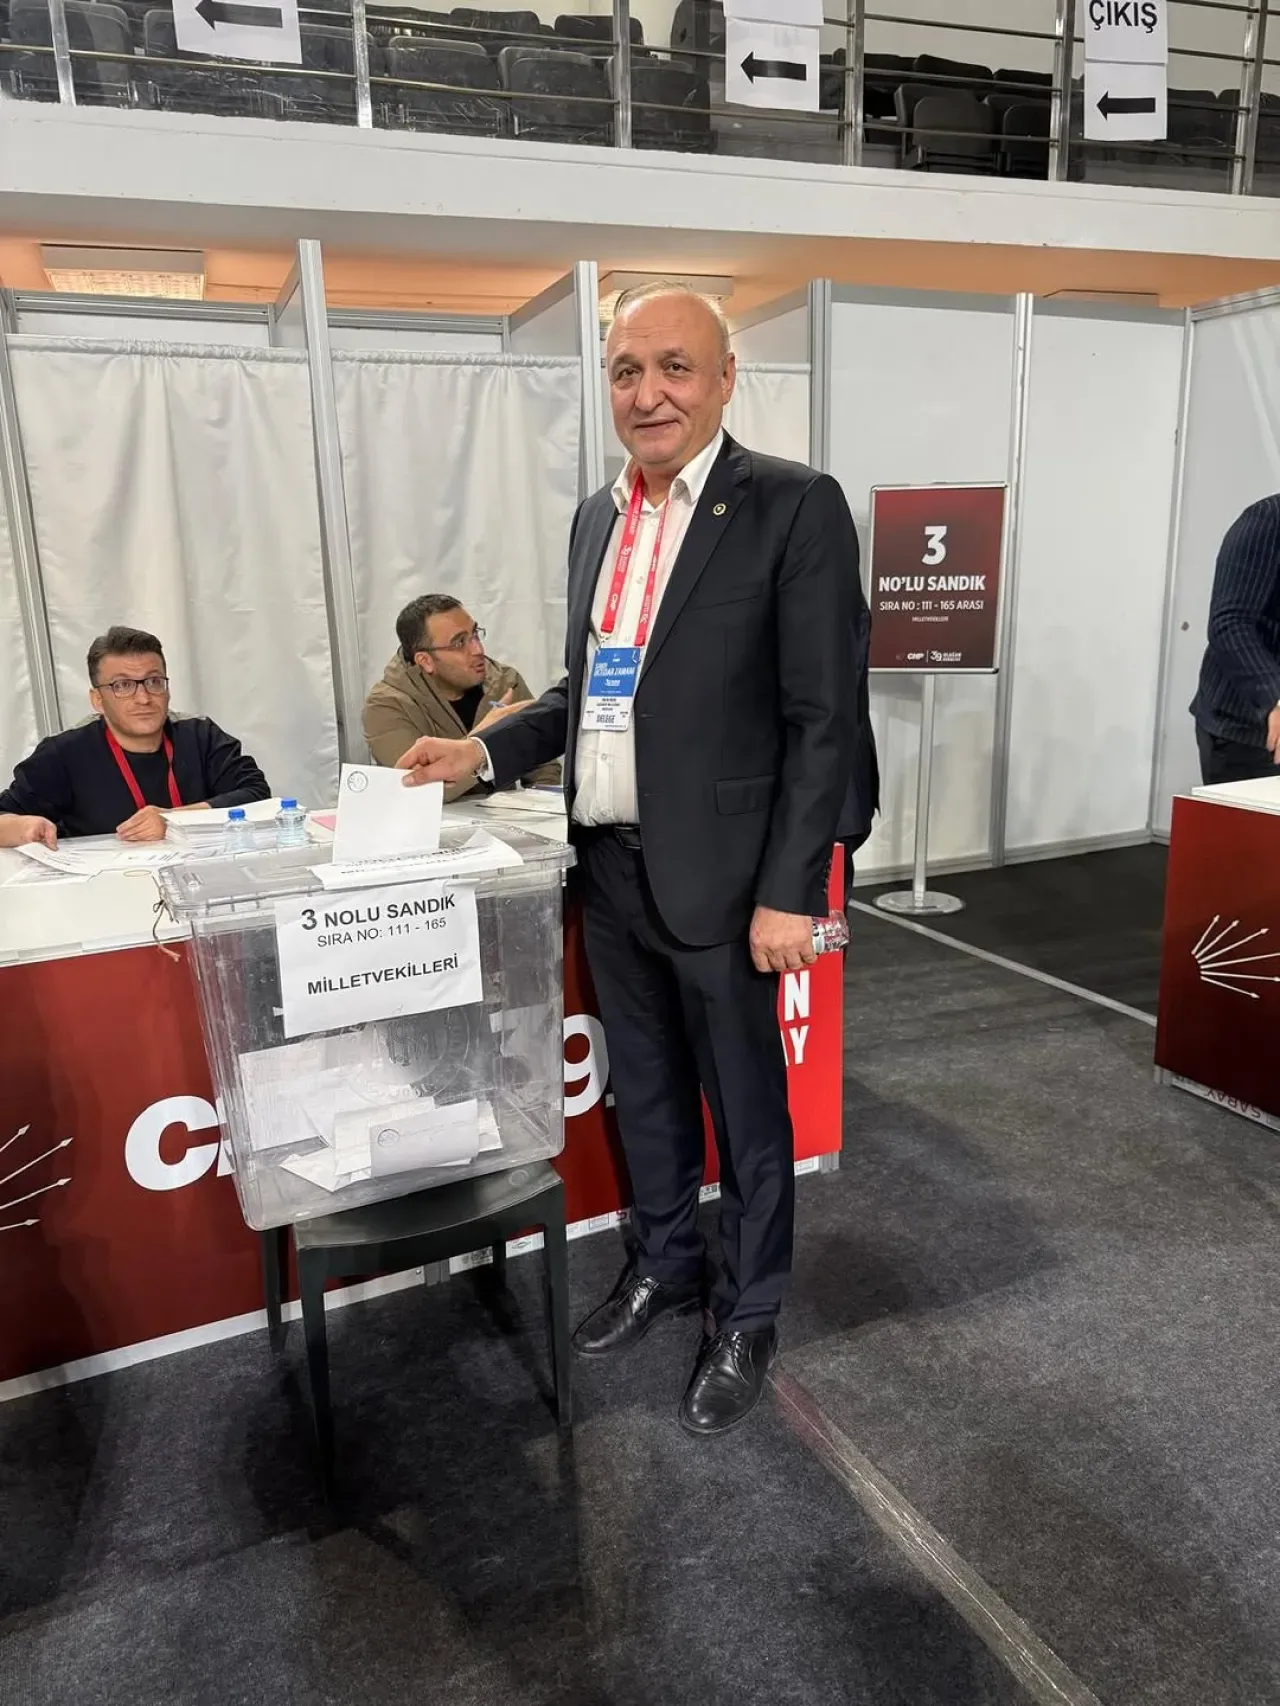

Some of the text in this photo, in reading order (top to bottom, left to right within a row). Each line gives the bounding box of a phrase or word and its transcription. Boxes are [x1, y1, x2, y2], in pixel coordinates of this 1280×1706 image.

[1089, 0, 1157, 33] ÇIKIŞ
[921, 525, 947, 565] 3
[927, 575, 986, 591] SANDIK
[880, 601, 900, 611] SIRA
[940, 601, 955, 610] 165
[956, 600, 984, 610] ARASI
[301, 894, 456, 930] 3 NOLU SANDIK
[317, 931, 353, 948] SIRA
[388, 923, 411, 936] 111
[425, 917, 447, 931] 165
[307, 953, 459, 995] MİLLETVEKİLLERİ
